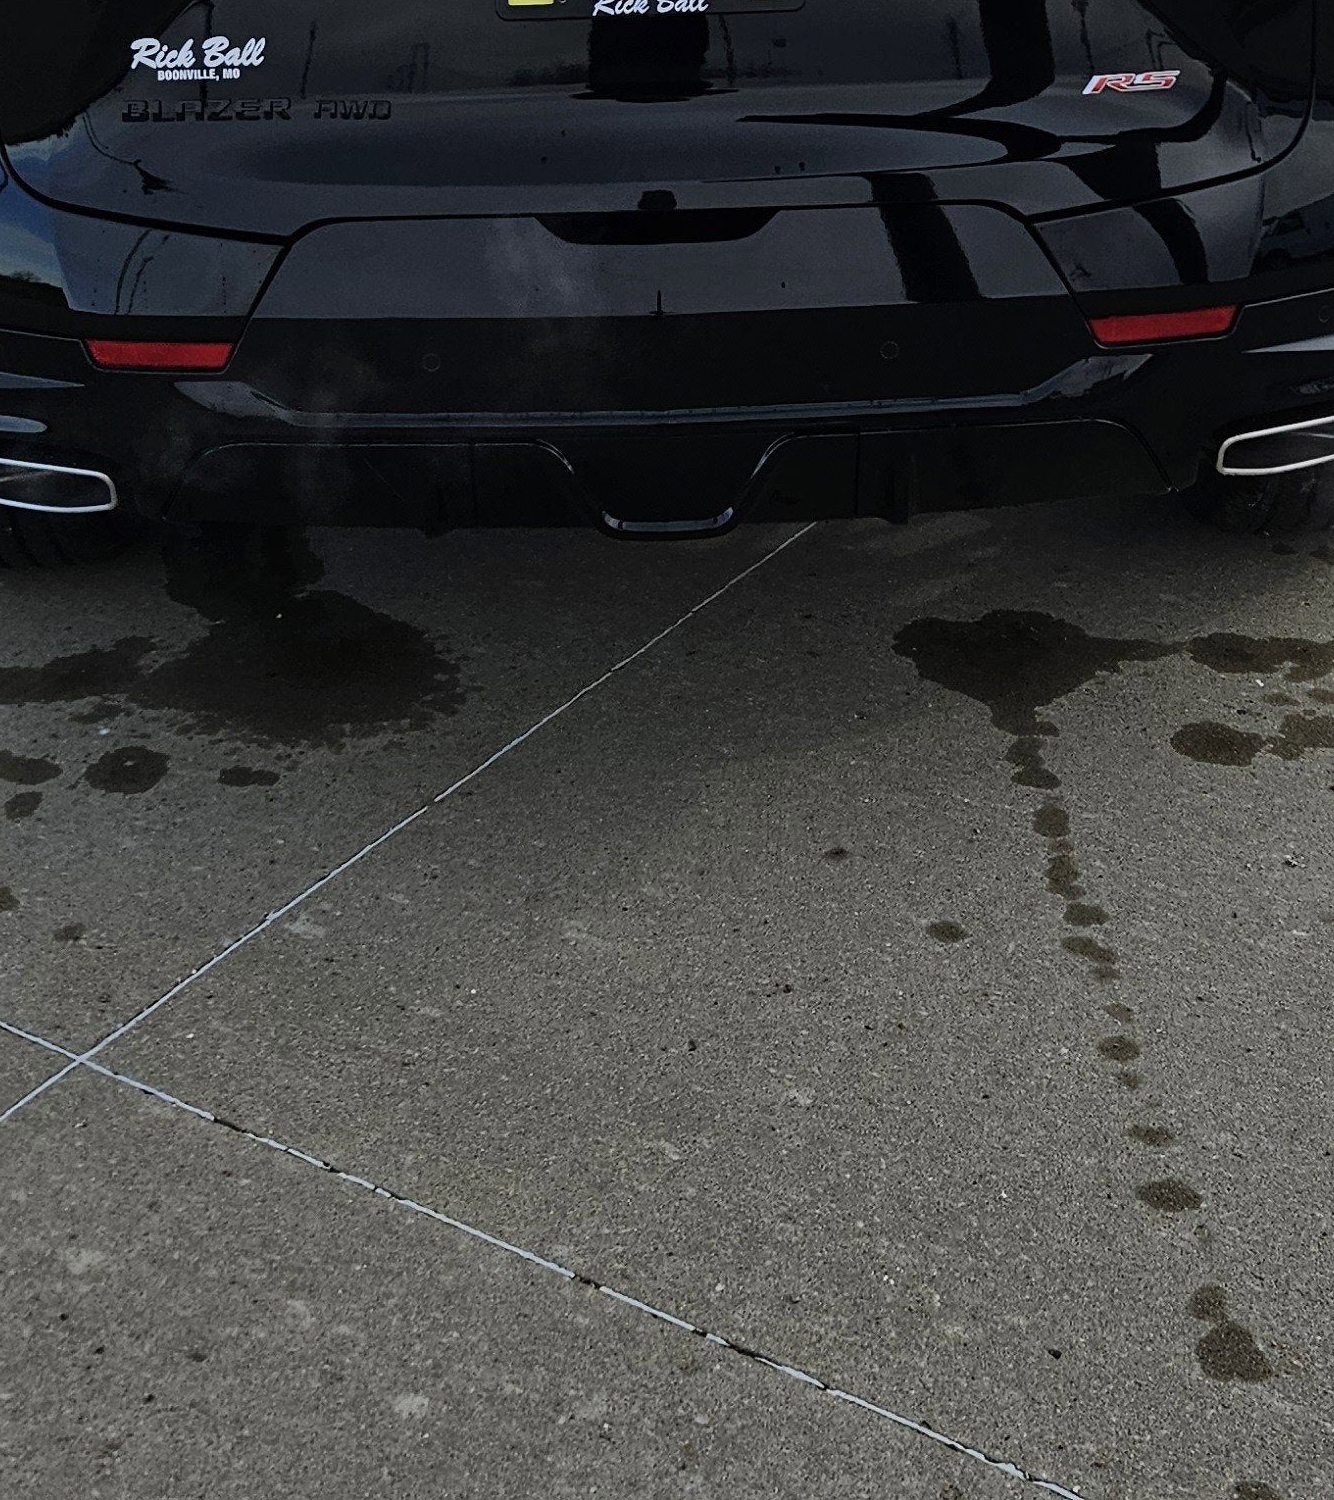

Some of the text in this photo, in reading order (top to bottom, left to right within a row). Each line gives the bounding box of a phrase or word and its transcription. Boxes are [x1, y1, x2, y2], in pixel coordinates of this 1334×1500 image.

[130, 35, 266, 70] Rick Ball
[157, 67, 241, 82] BOONVILLE, MO
[1081, 69, 1182, 95] RS
[121, 97, 392, 123] BLAZER AWD
